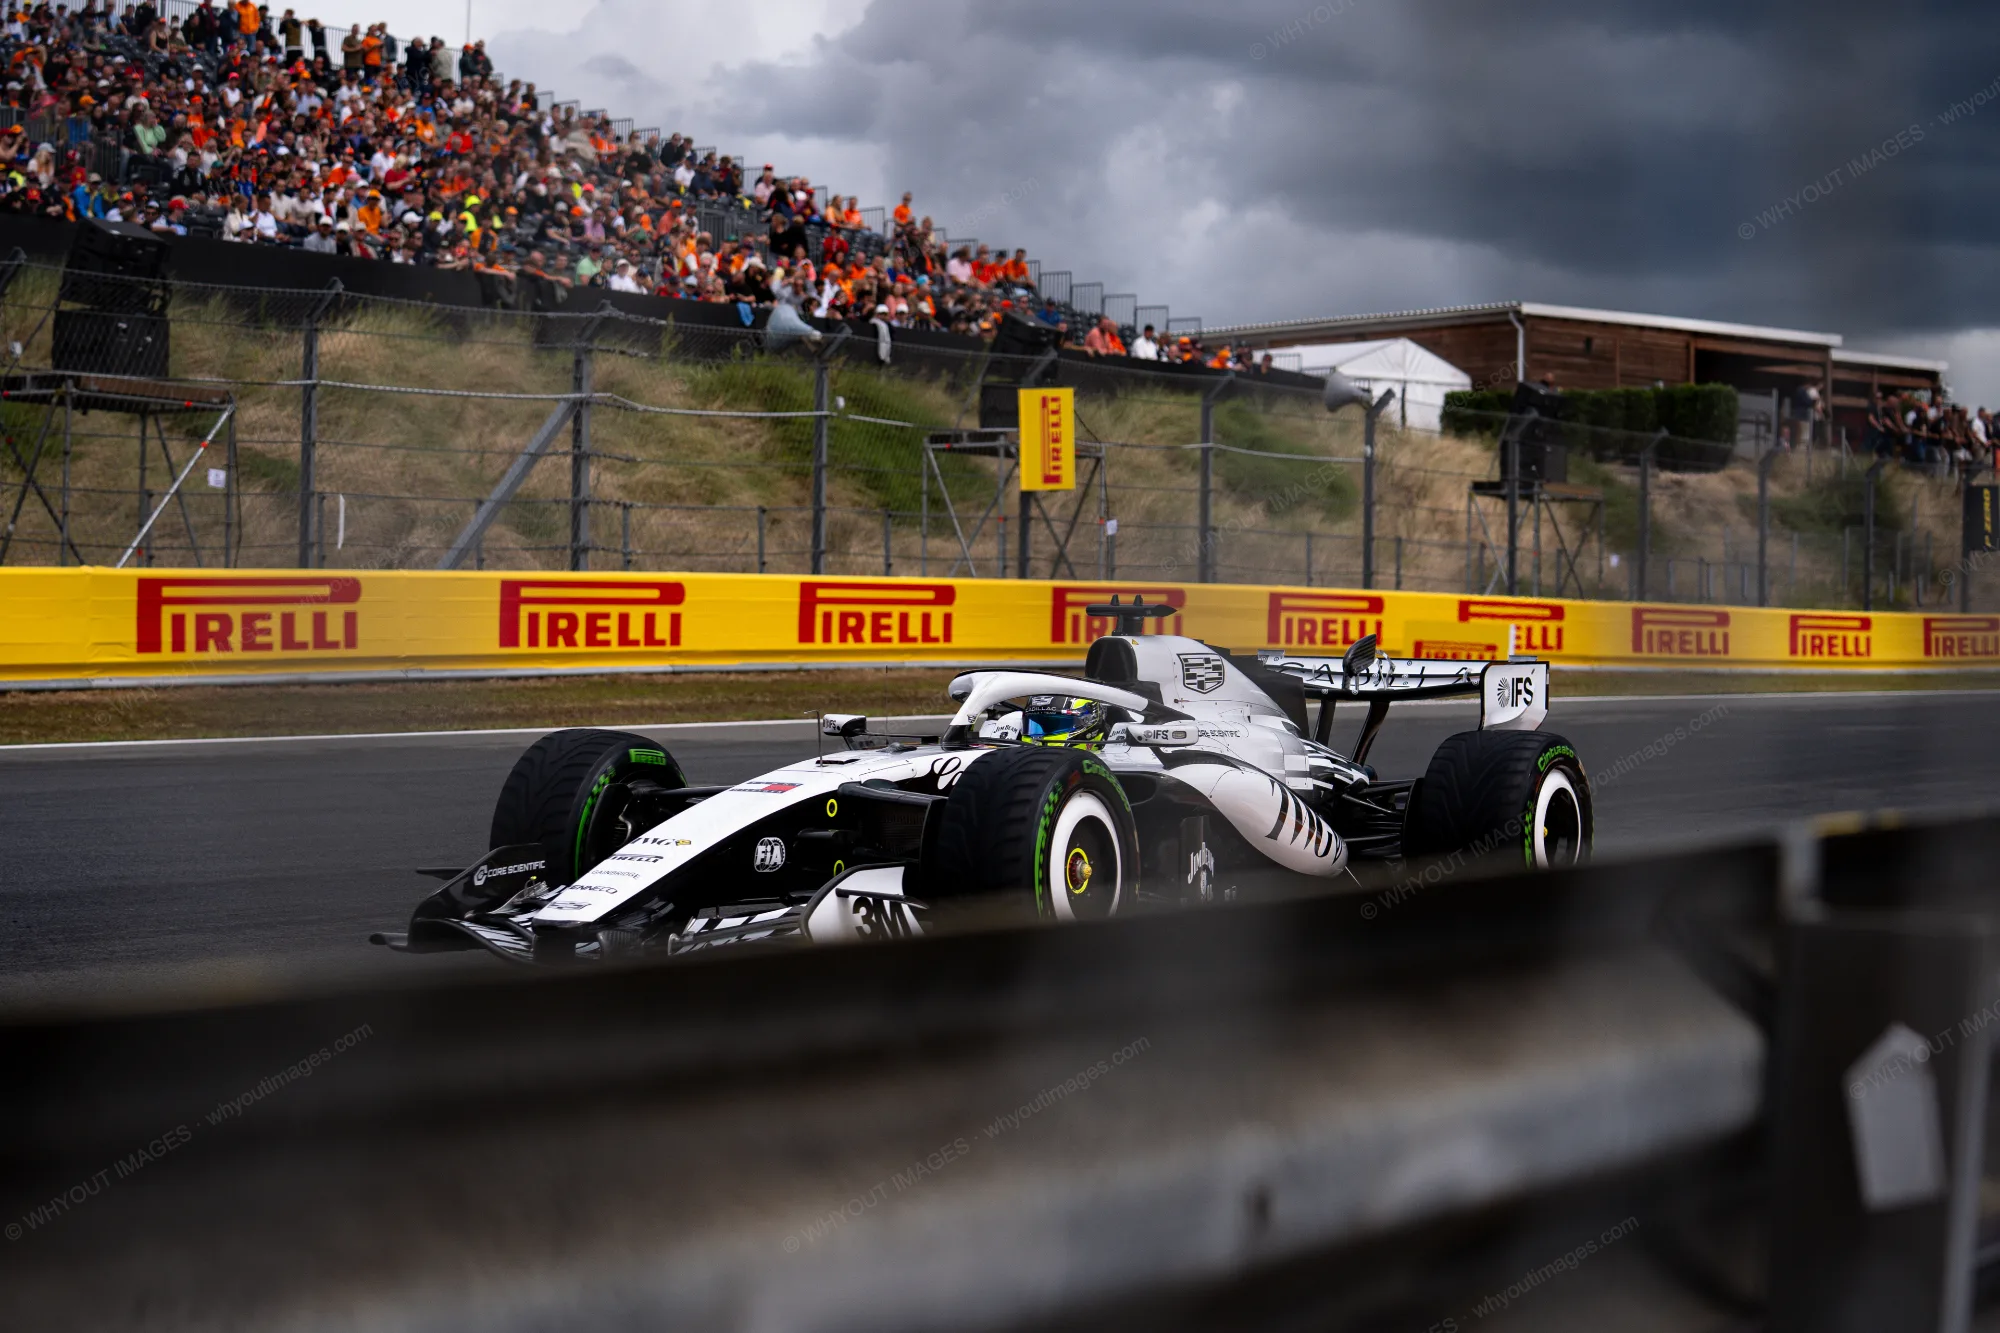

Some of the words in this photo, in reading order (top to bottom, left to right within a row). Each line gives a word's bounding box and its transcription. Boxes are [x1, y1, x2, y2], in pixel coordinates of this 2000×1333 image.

[1042, 396, 1061, 484] PIRELLI
[137, 578, 361, 653] PIRELLI
[499, 580, 685, 648] PIRELLI
[799, 582, 955, 643] PIRELLI
[1632, 607, 1730, 656] PIRELLI
[1789, 615, 1871, 656] PIRELLI
[1511, 676, 1534, 707] IFS
[1153, 730, 1168, 740] IFS
[488, 866, 507, 878] CORE
[508, 860, 546, 874] SCIENTIFIC
